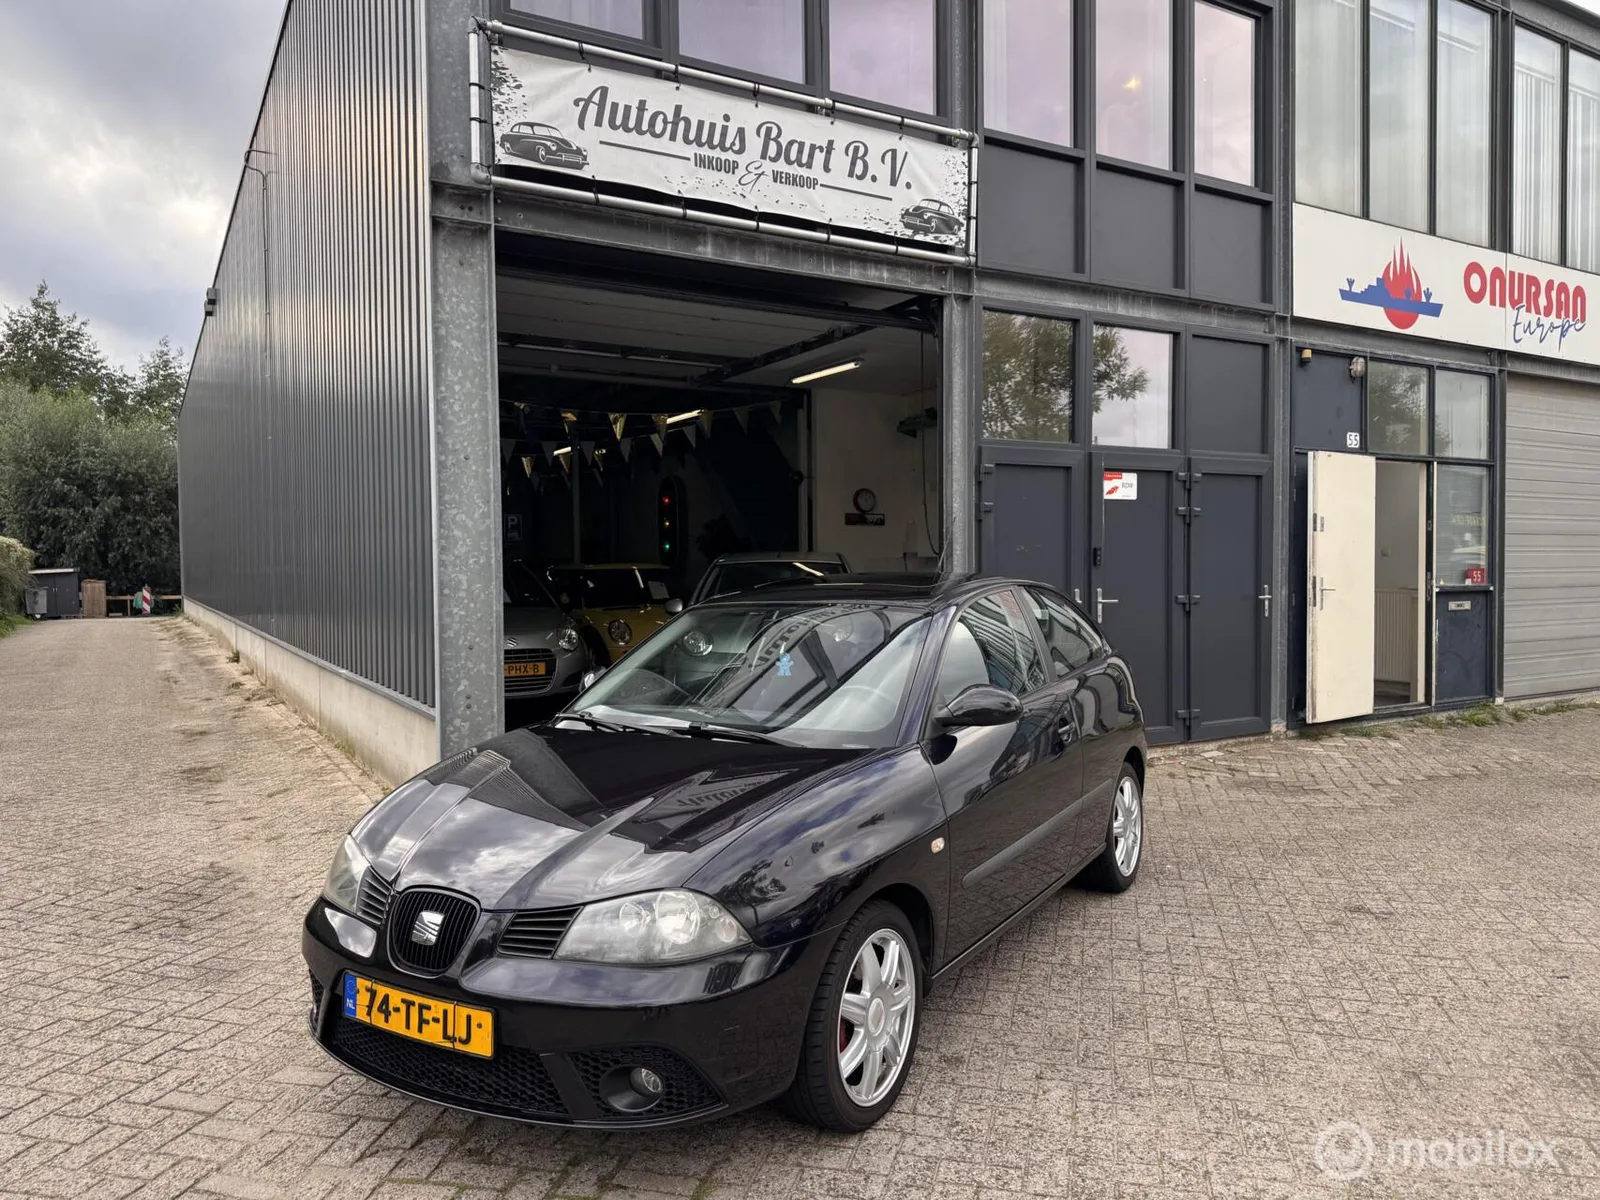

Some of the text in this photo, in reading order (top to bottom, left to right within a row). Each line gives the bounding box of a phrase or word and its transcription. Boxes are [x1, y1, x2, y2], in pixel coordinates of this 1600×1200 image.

[573, 85, 912, 190] Autohuis Bart B.V.
[693, 152, 819, 194] INKOOP & VERKOOP
[1464, 261, 1587, 324] ONURSAN
[1512, 304, 1586, 353] Europe
[1348, 433, 1359, 447] 55
[507, 516, 519, 530] P
[1473, 570, 1482, 582] 55
[365, 985, 472, 1045] 74-TF-LJ
